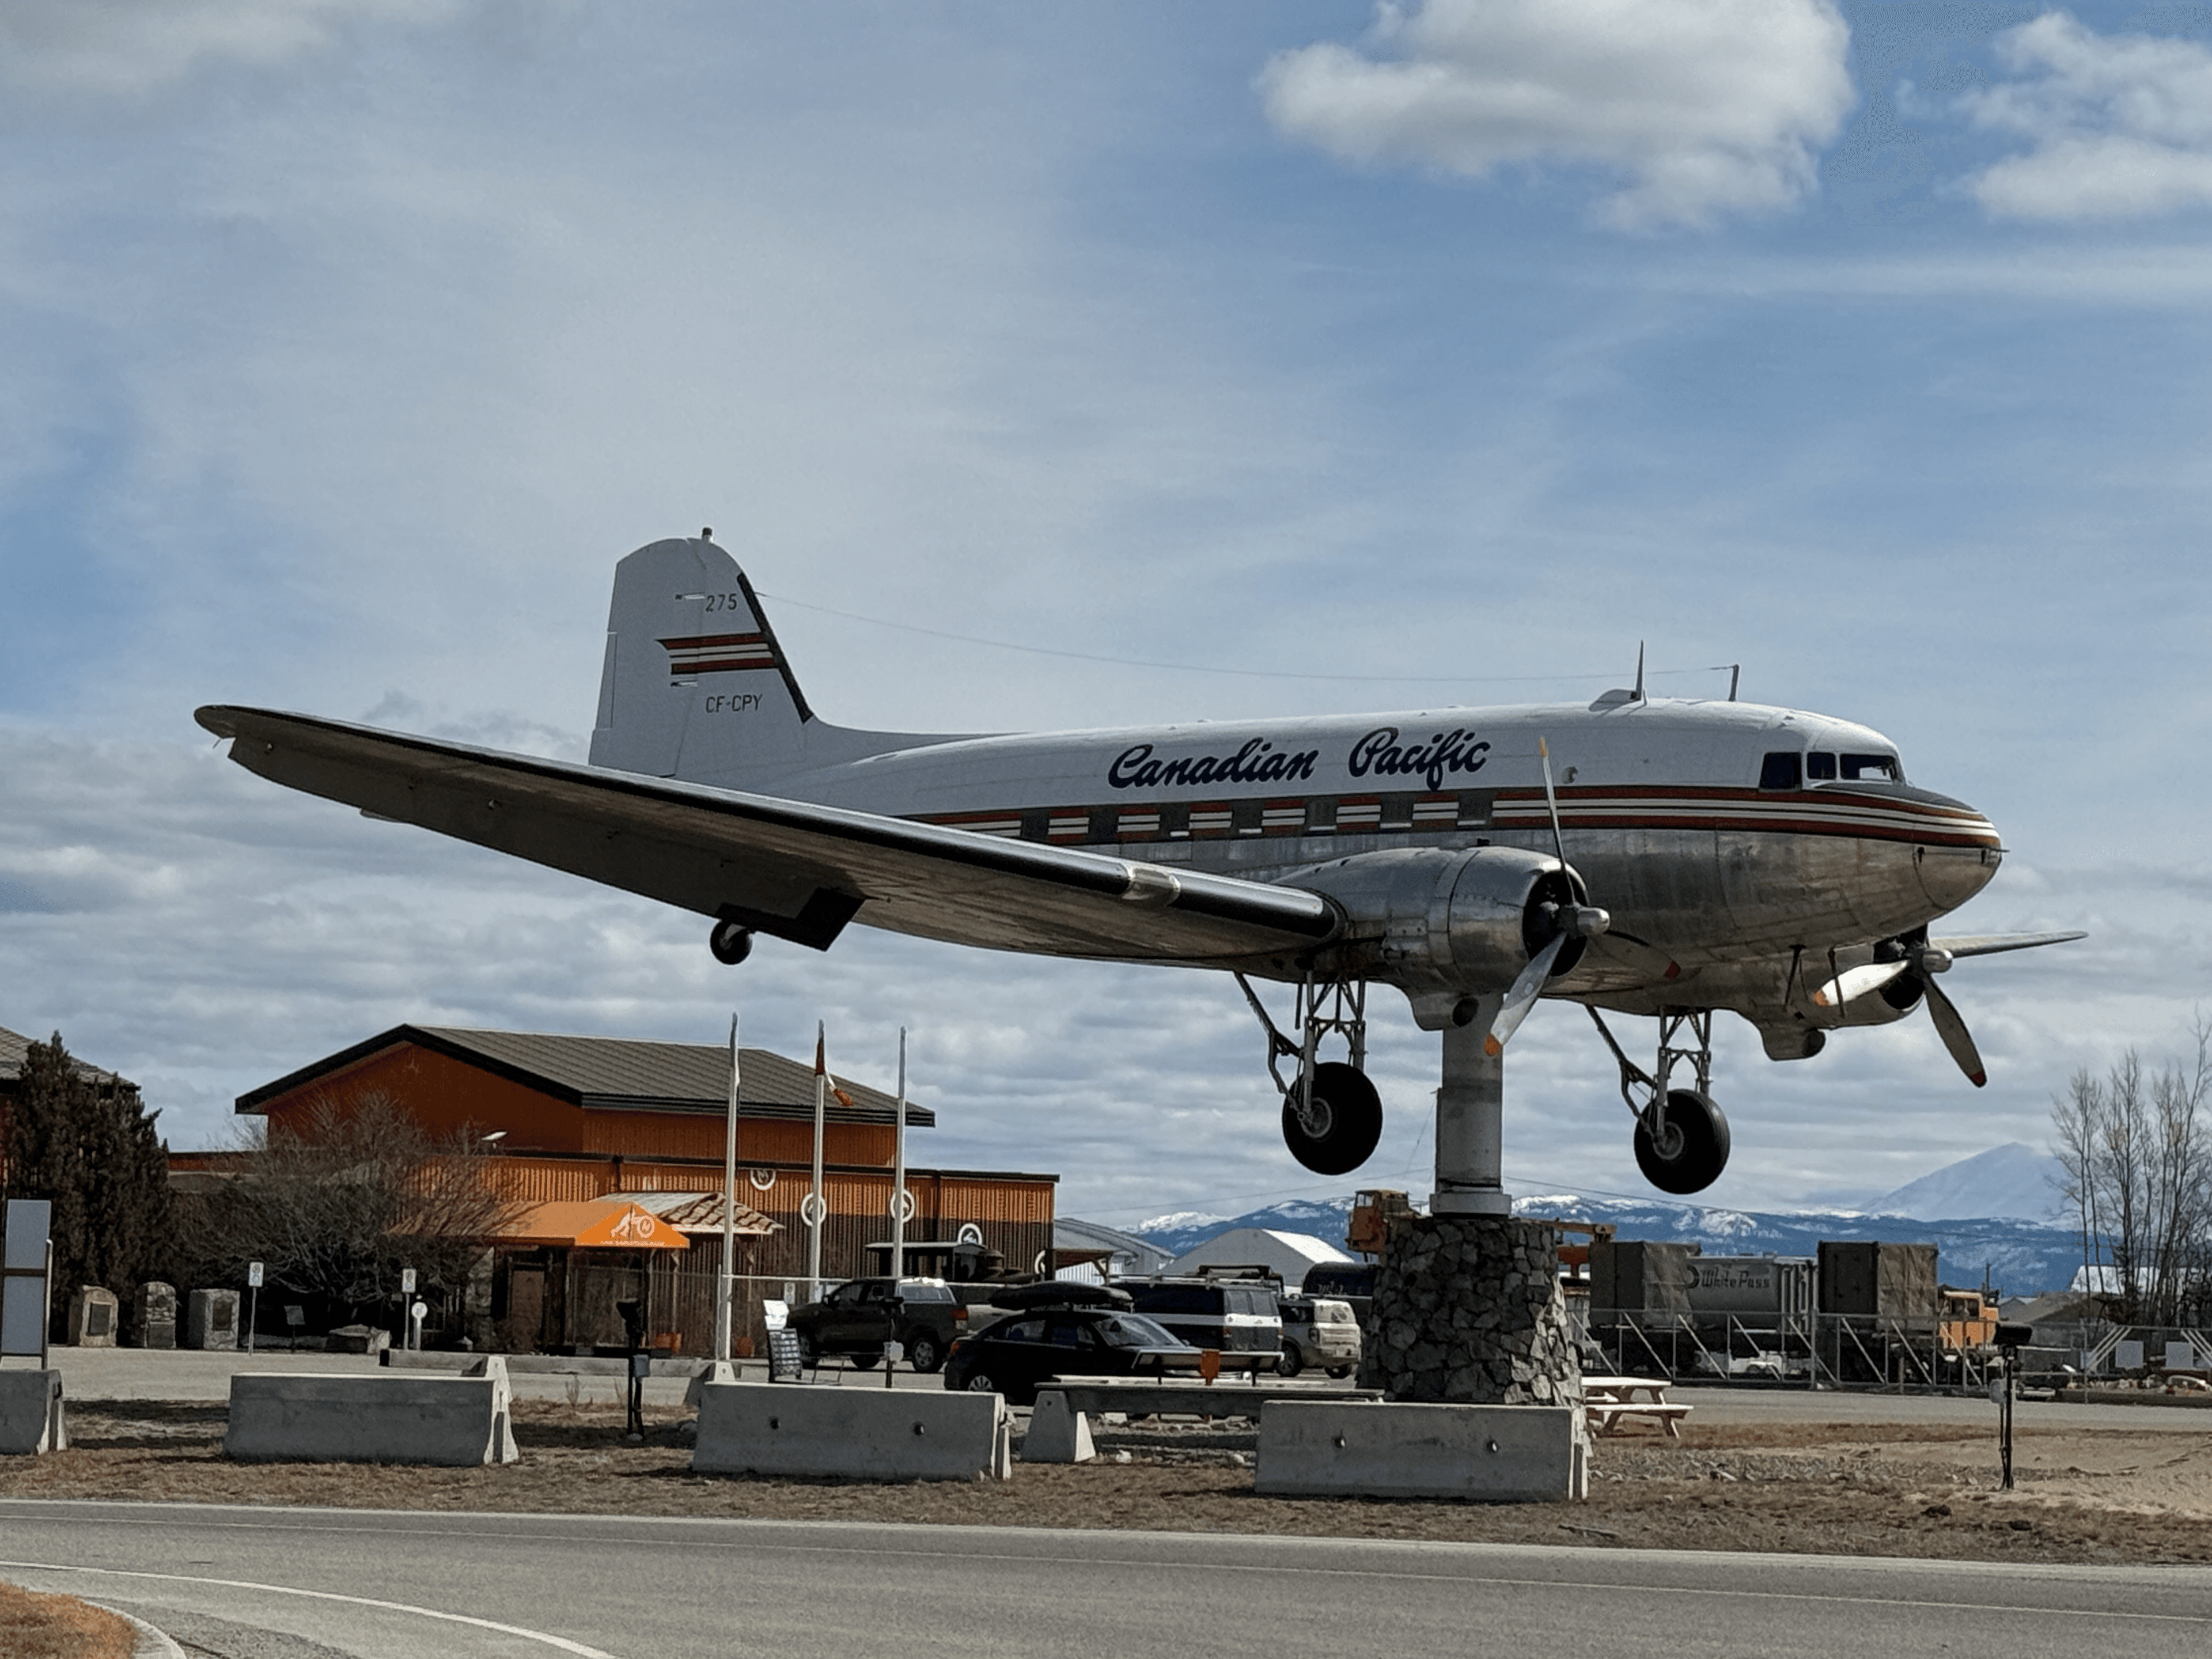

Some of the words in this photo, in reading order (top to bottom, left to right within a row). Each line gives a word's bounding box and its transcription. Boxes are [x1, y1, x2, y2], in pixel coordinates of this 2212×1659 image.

[705, 593, 737, 612] 275
[706, 694, 763, 713] CF-CPY
[1107, 737, 1319, 789] Canadian
[1349, 726, 1492, 791] Pacific
[1701, 1267, 1737, 1288] White
[1738, 1270, 1770, 1288] Pass
